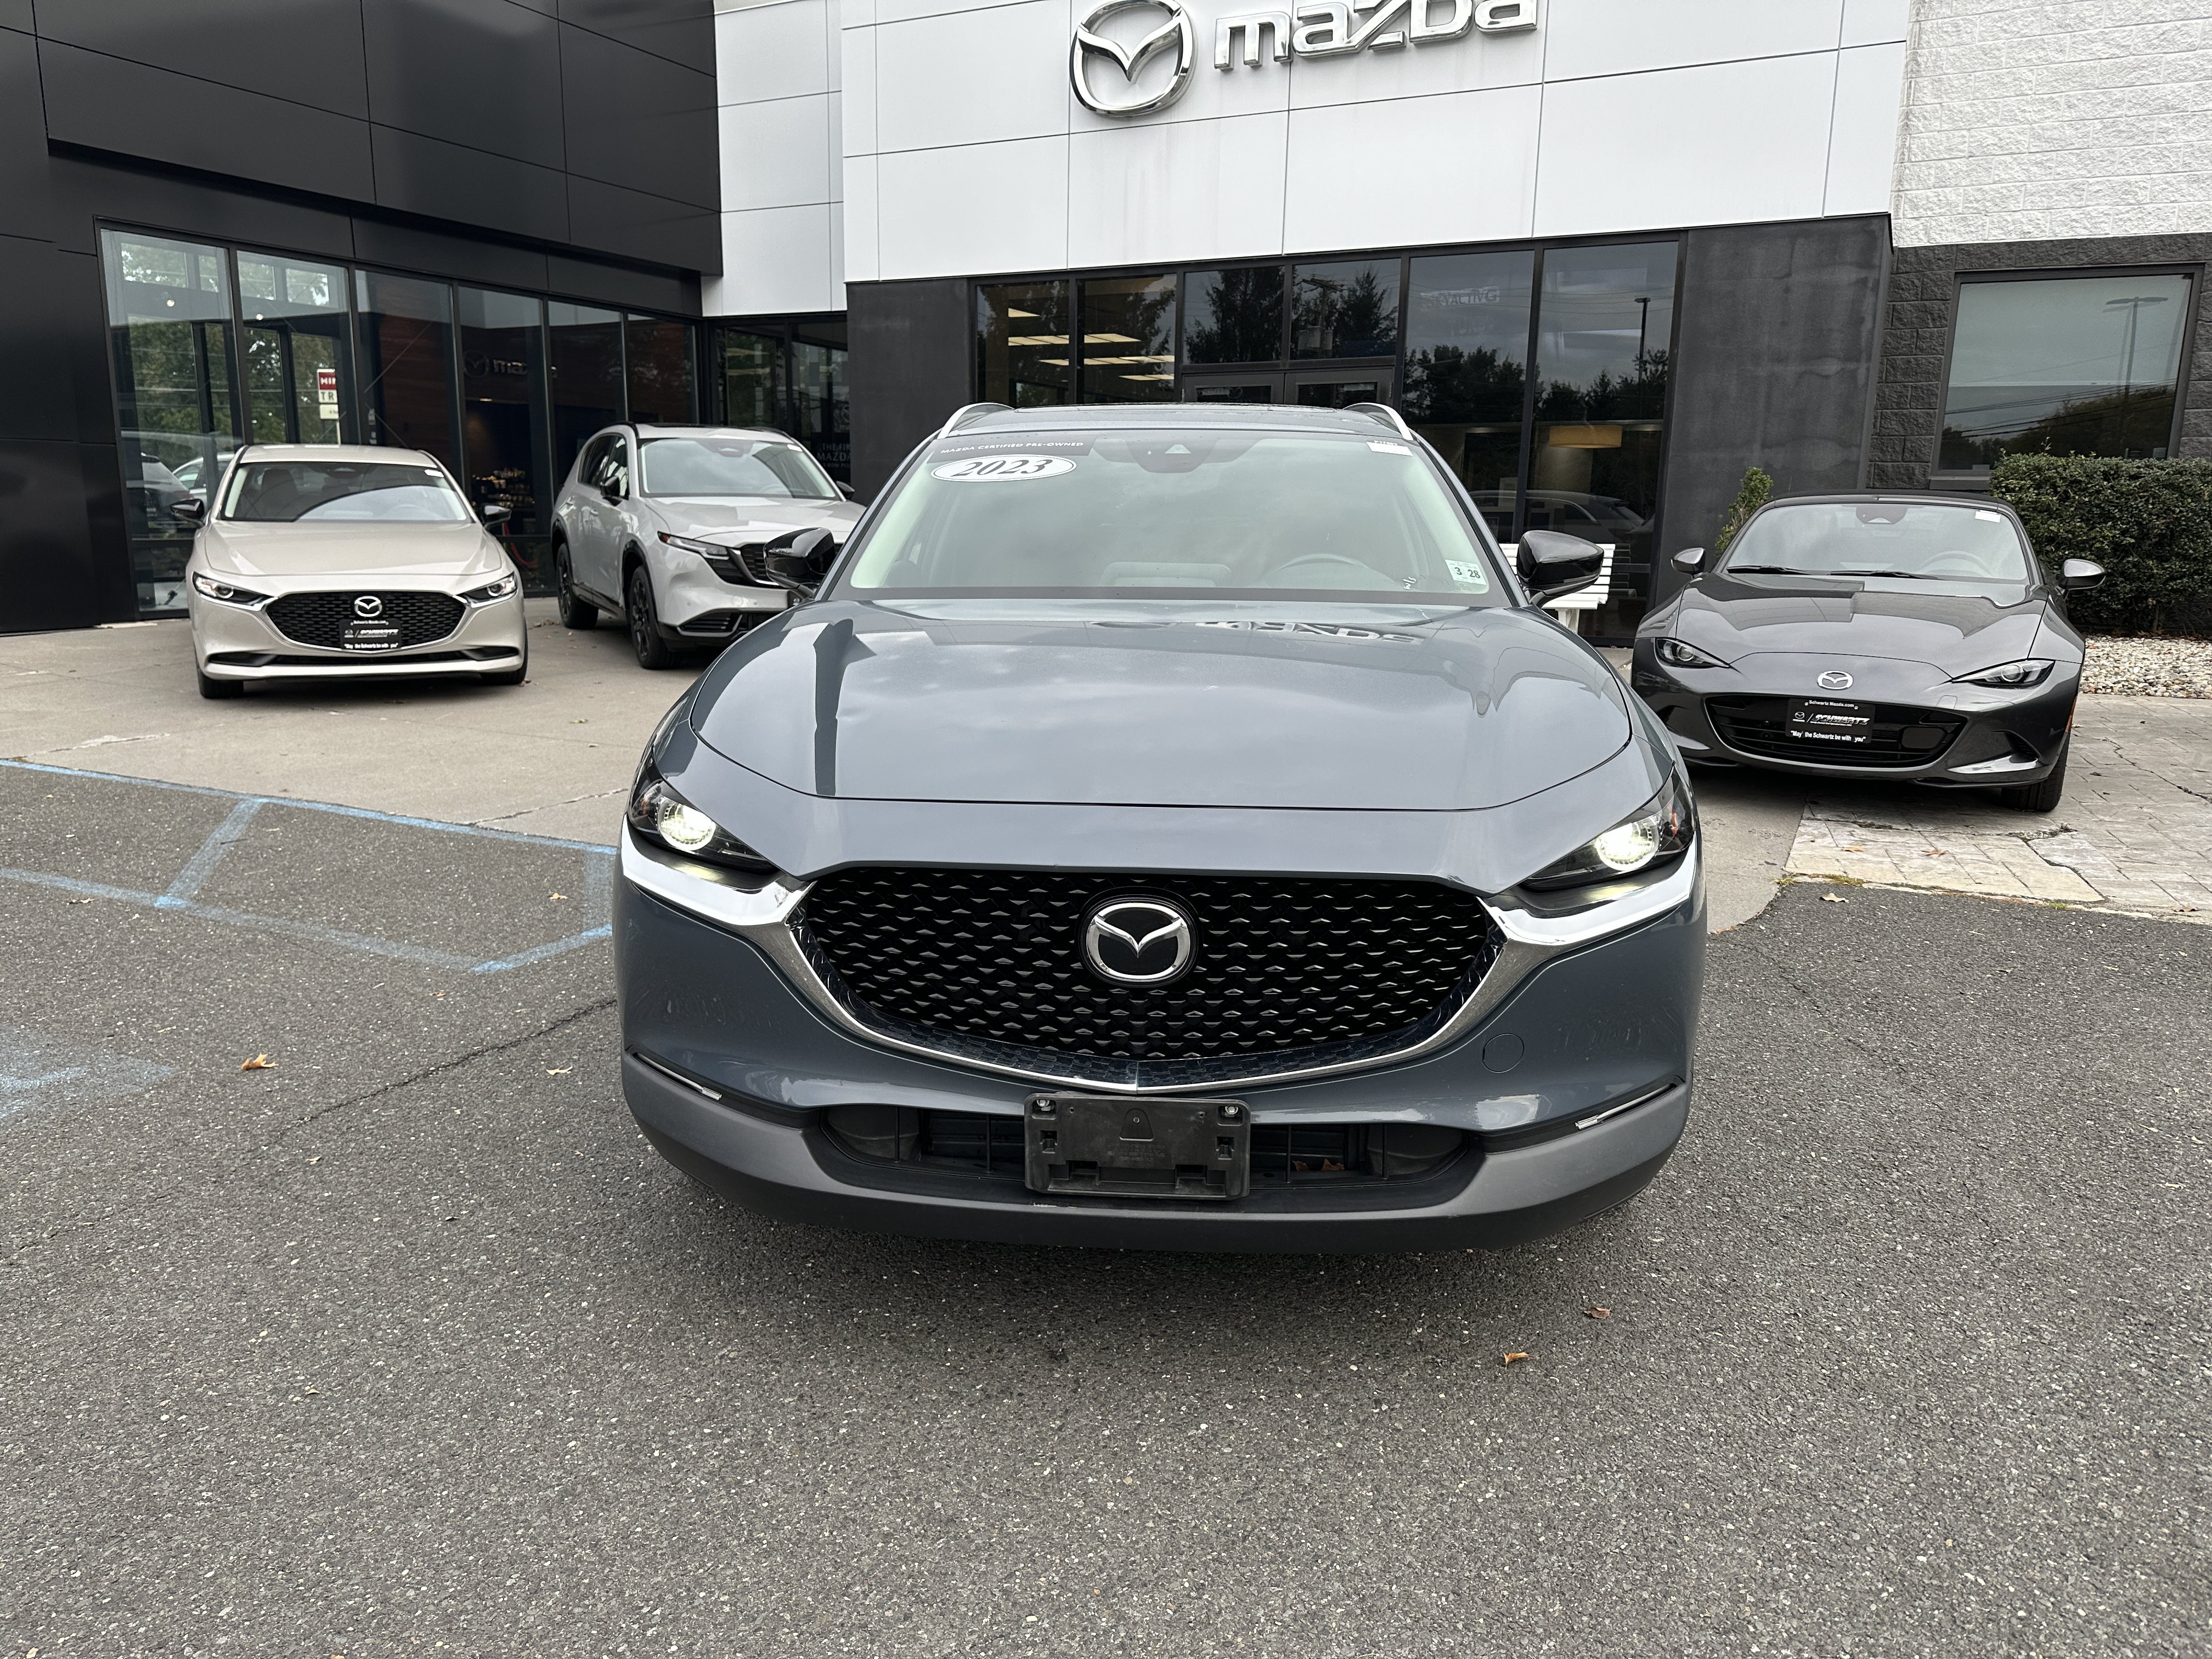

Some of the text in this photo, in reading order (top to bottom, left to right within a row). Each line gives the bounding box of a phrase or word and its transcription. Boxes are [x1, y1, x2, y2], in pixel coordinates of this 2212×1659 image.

[940, 445, 975, 454] MAZDA
[950, 459, 1053, 477] 2023
[1454, 567, 1481, 579] 3 28
[1812, 714, 1870, 725] SCHWARTZ
